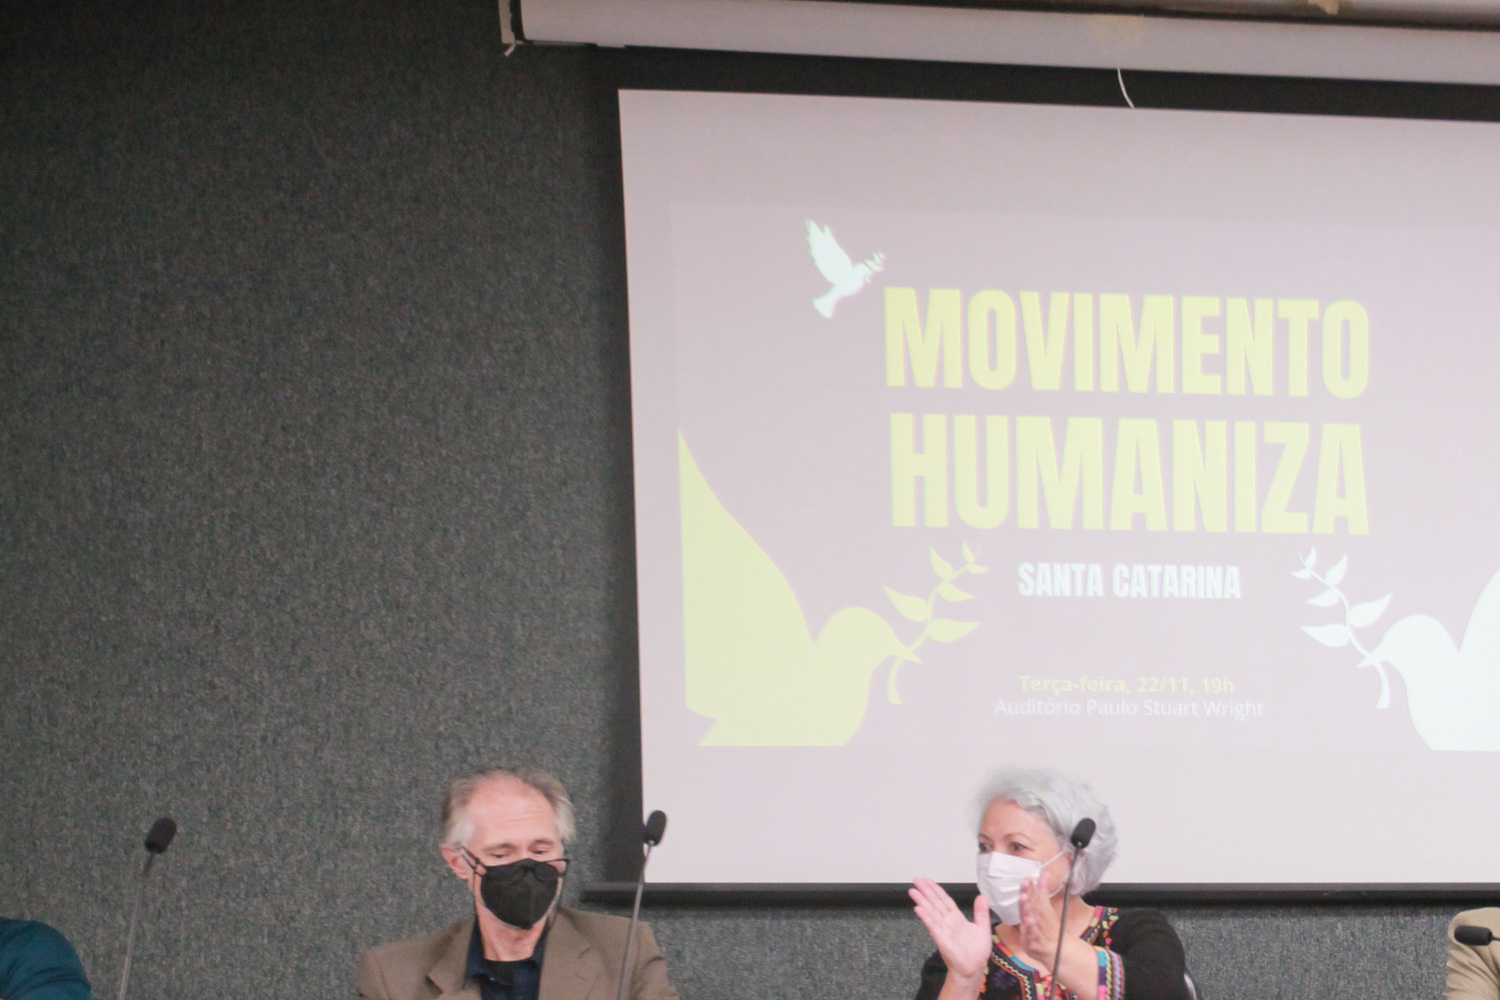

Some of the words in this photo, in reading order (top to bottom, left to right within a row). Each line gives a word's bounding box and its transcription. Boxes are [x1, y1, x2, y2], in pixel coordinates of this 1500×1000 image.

[883, 286, 1370, 399] MOVIMENTO
[889, 412, 1370, 535] HUMANIZA
[1016, 562, 1104, 597] SANTA
[1112, 563, 1241, 599] CATARINA
[1018, 675, 1130, 695] Terça-feira,
[1136, 677, 1195, 695] 22/11,
[1202, 678, 1234, 693] 19h
[994, 699, 1080, 715] Auditório
[1087, 700, 1136, 715] Paulo
[1143, 700, 1197, 716] Stuart
[1203, 700, 1264, 721] Wright
